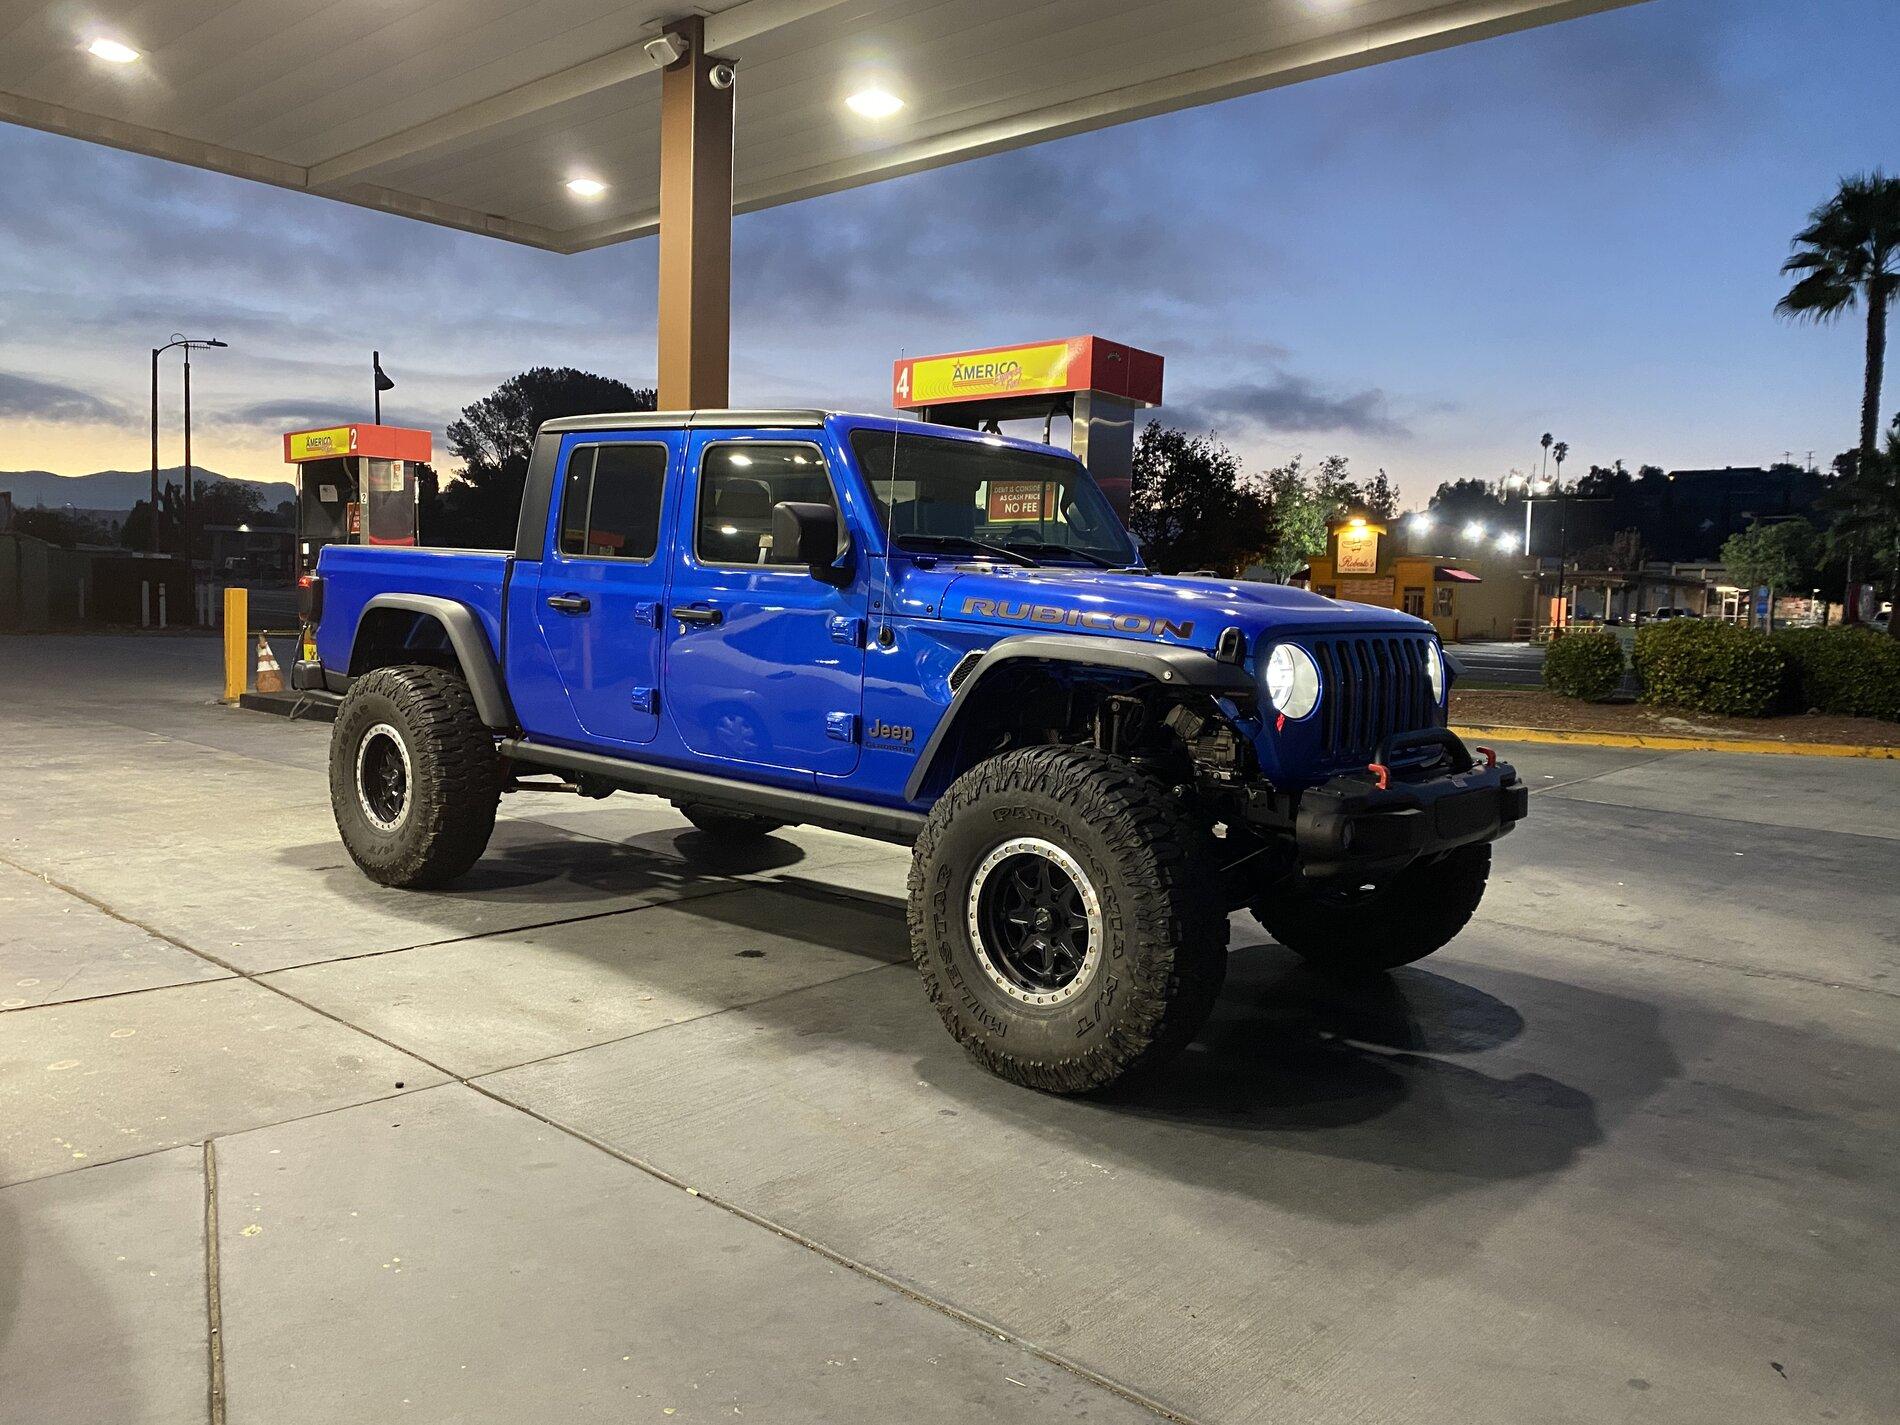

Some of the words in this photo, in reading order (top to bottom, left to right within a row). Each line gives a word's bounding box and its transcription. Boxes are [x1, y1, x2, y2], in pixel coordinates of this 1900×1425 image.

[952, 361, 1019, 381] AMERICO
[896, 367, 910, 399] 4
[350, 428, 357, 450] 2
[361, 493, 367, 503] 2
[1000, 494, 1007, 502] AS
[1004, 503, 1020, 513] NO
[1022, 502, 1038, 513] FEE
[1338, 555, 1375, 568] Roberto's
[960, 597, 1195, 640] RUBICON
[869, 718, 913, 745] Jeep
